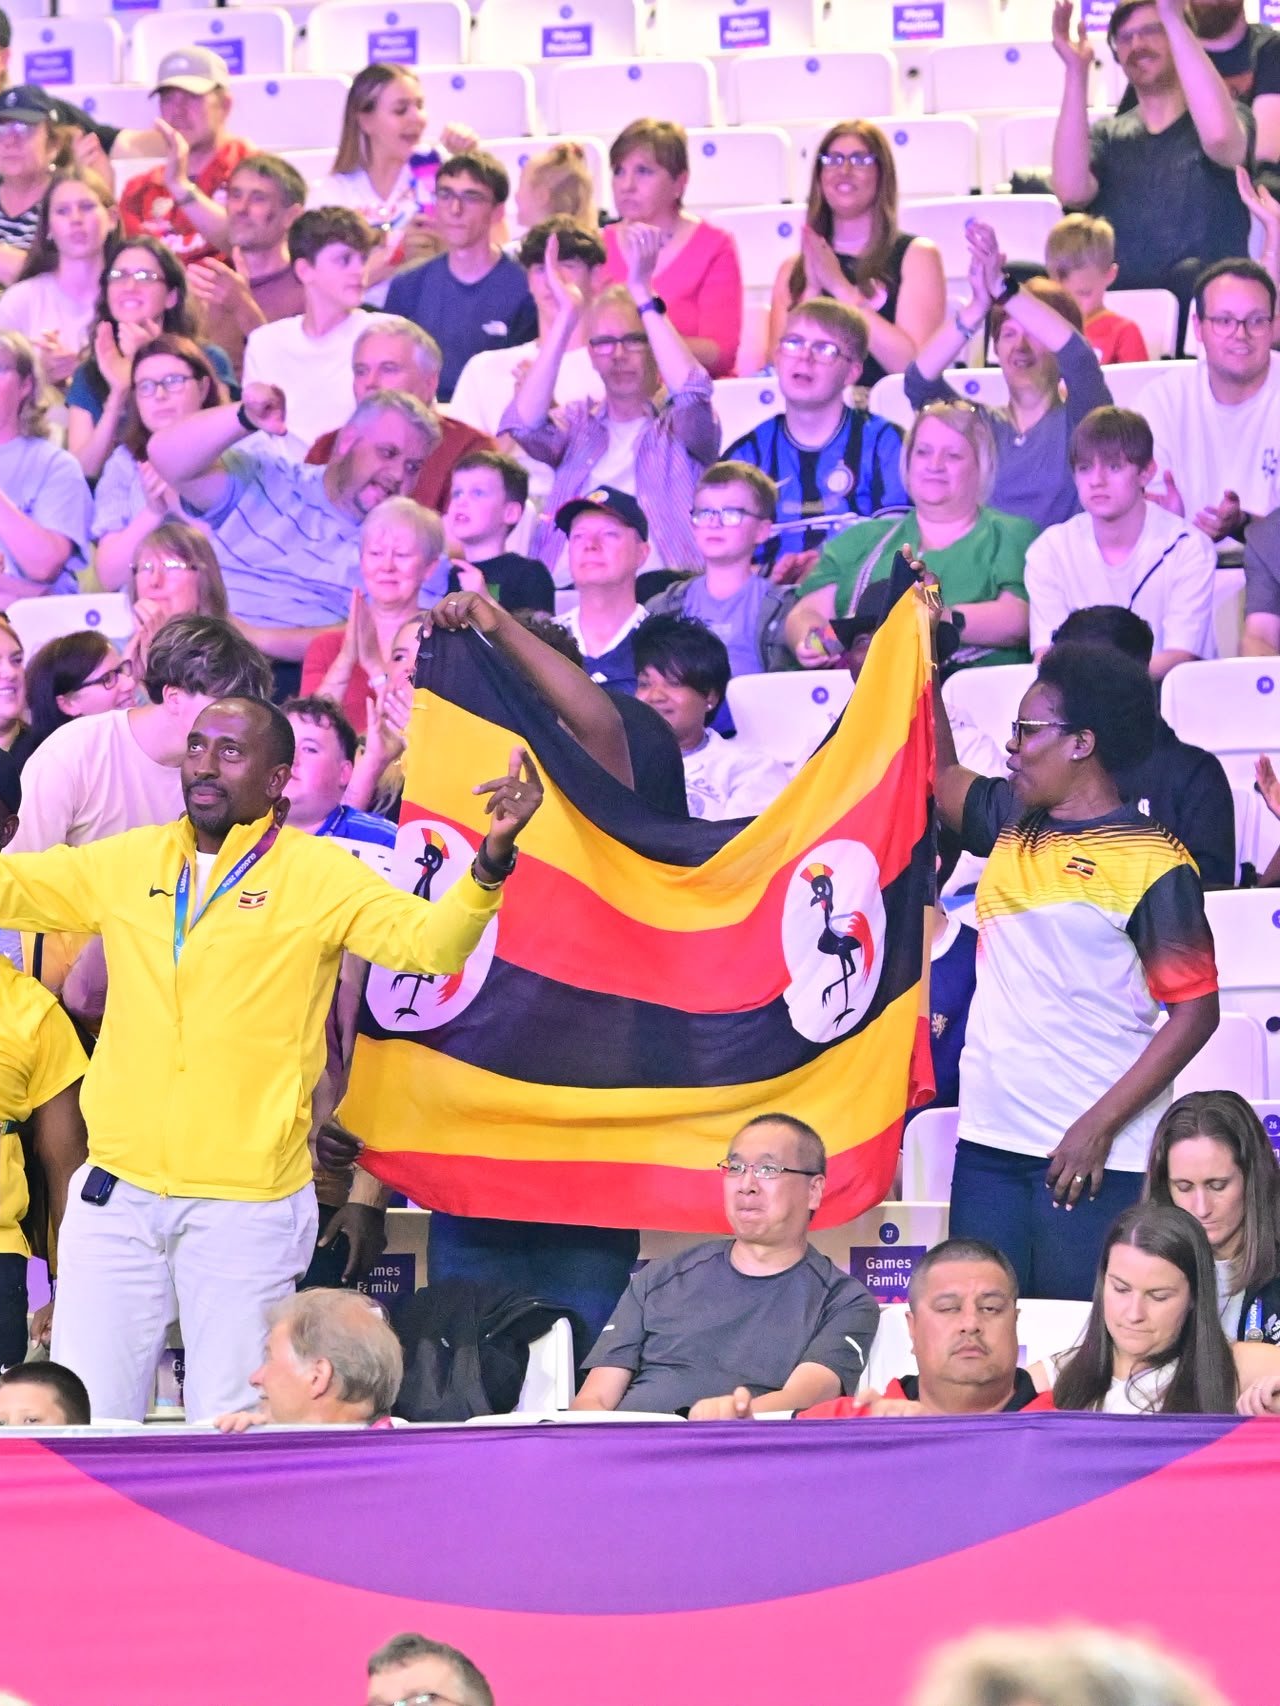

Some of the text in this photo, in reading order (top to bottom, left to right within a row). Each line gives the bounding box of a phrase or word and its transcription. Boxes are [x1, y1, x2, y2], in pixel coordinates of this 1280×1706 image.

[235, 853, 257, 877] GLASGOW
[865, 1257, 912, 1270] Games
[369, 1266, 401, 1276] mes
[866, 1273, 911, 1289] Family
